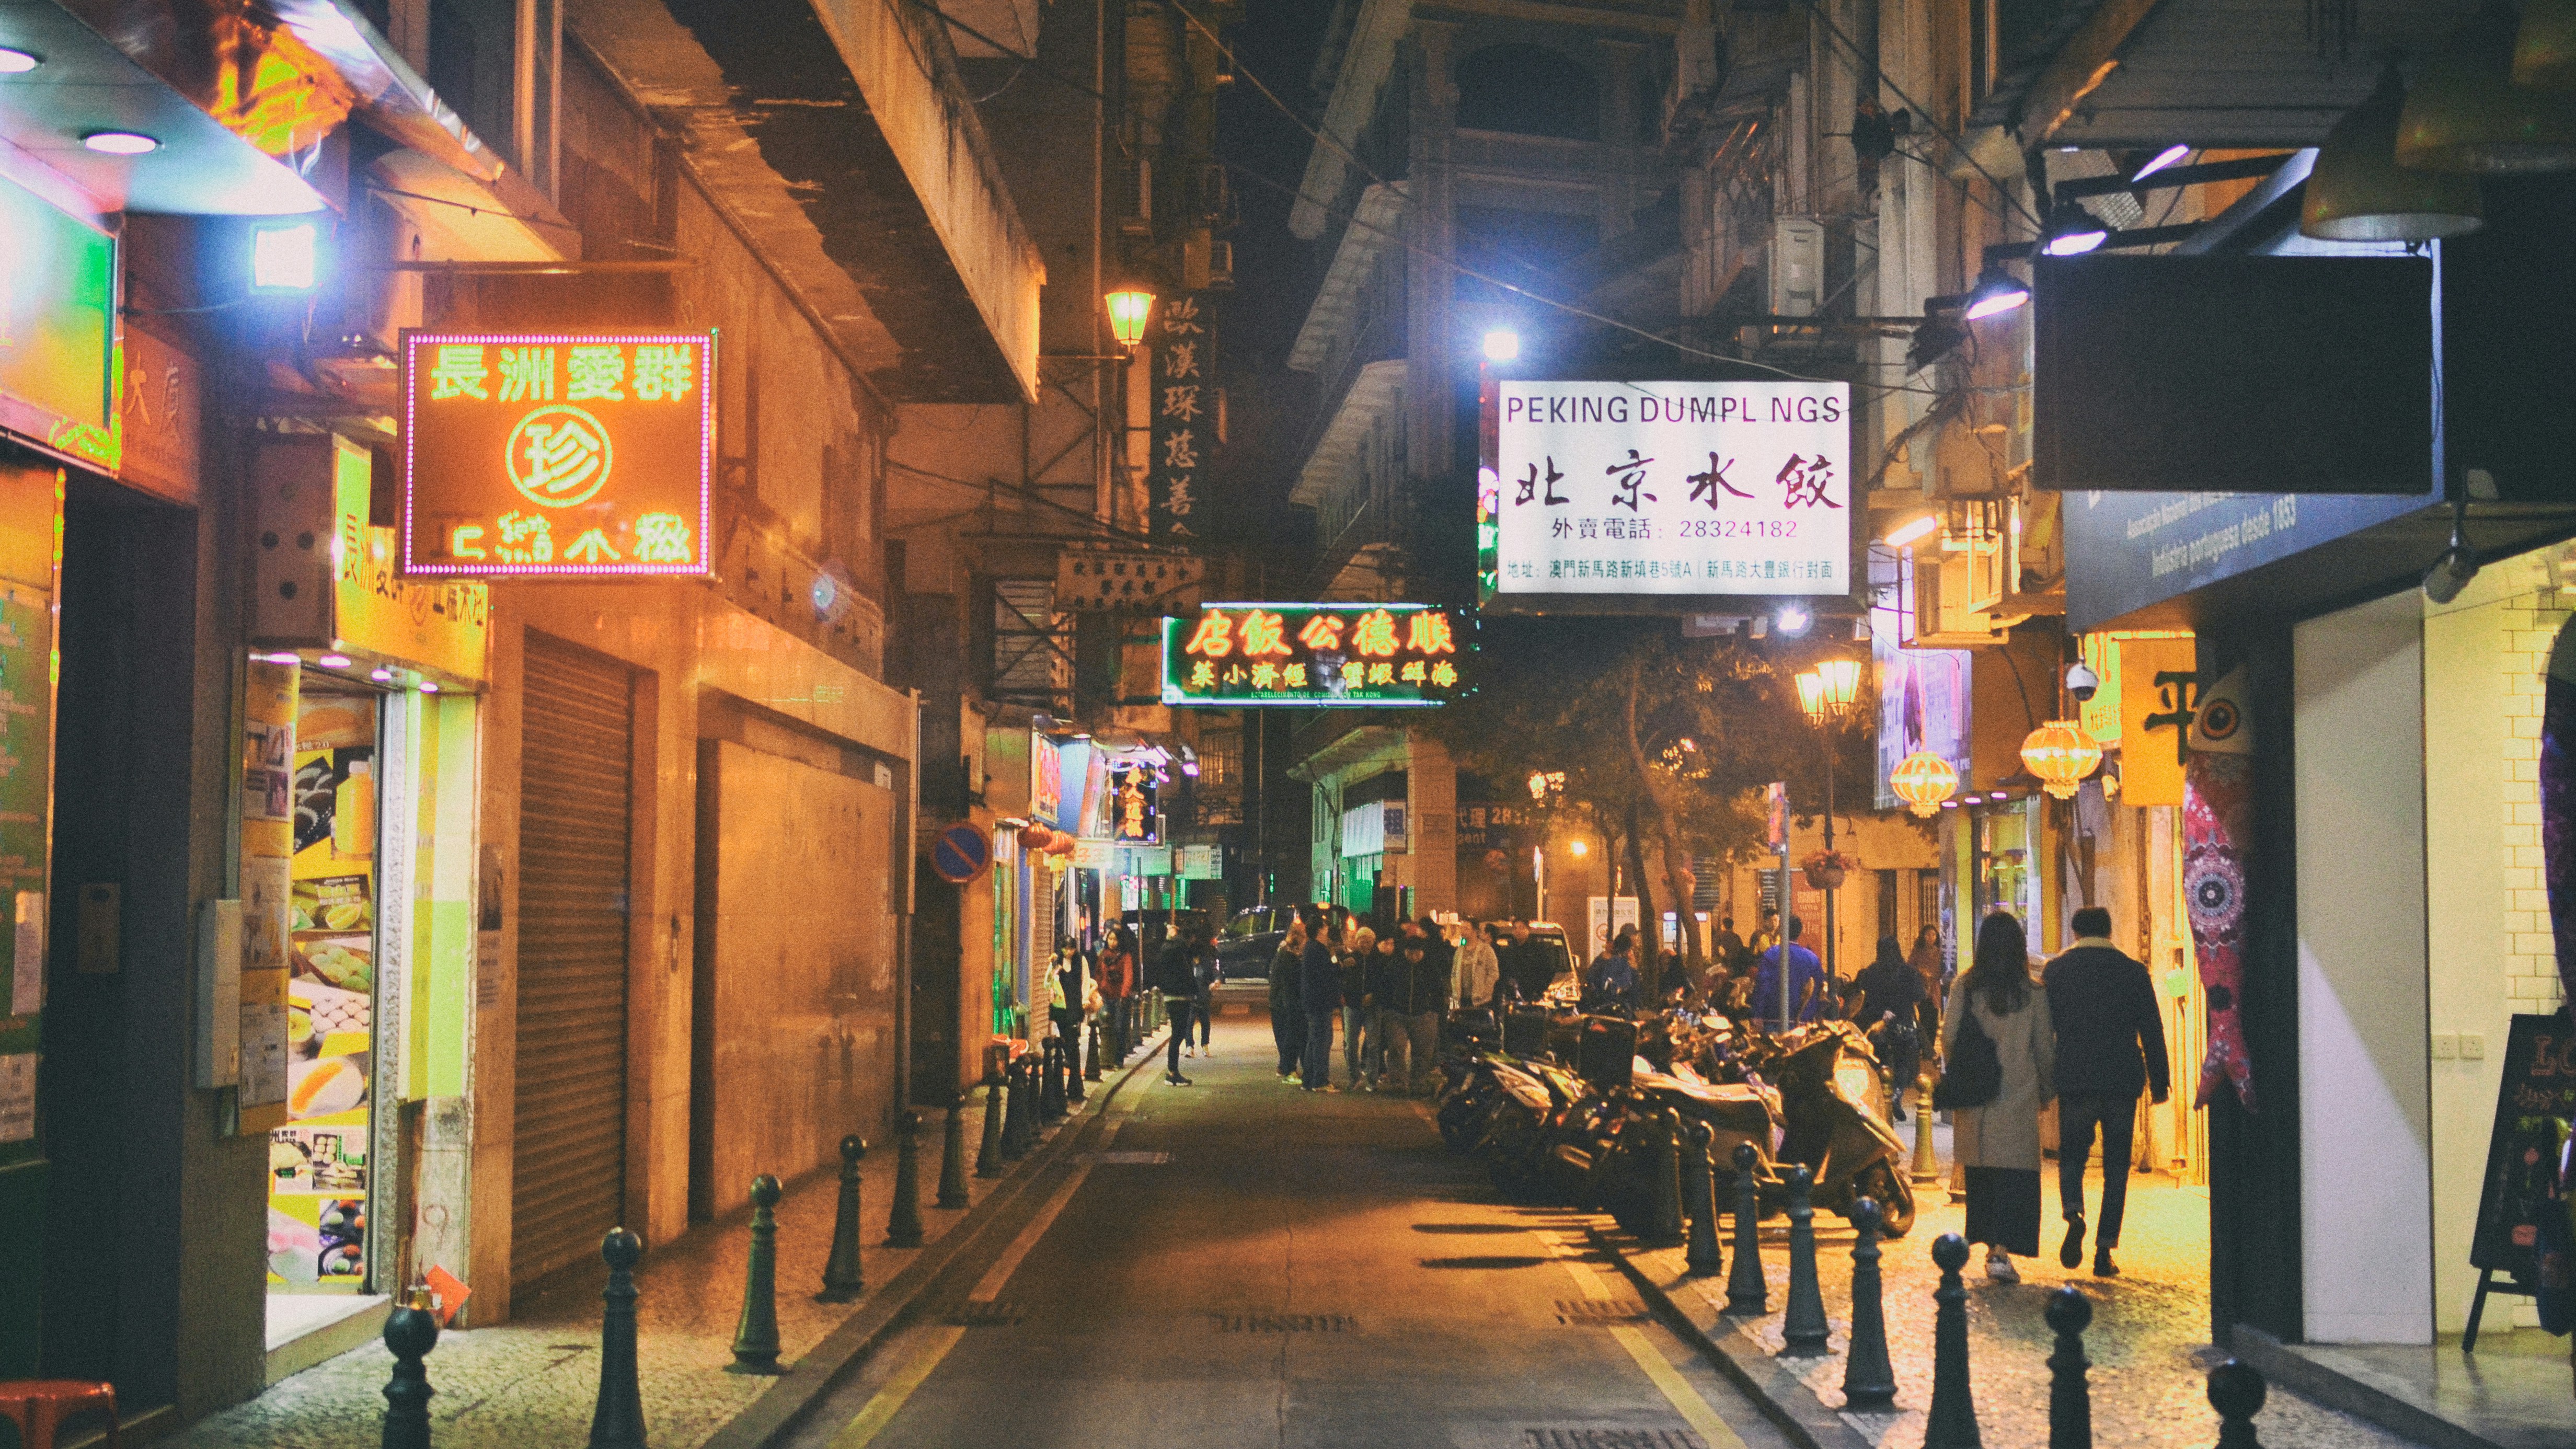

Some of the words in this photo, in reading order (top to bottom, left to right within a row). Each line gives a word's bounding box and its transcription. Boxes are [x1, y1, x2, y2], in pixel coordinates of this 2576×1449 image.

[431, 344, 692, 401] 長洲愛群
[1508, 396, 1628, 423] PEKING
[522, 420, 600, 493] 珍
[1516, 449, 1844, 512] 北京水餃
[1552, 518, 1662, 539] 外賣電話:
[1680, 520, 1797, 538] 28324182
[2241, 506, 2270, 544] desde
